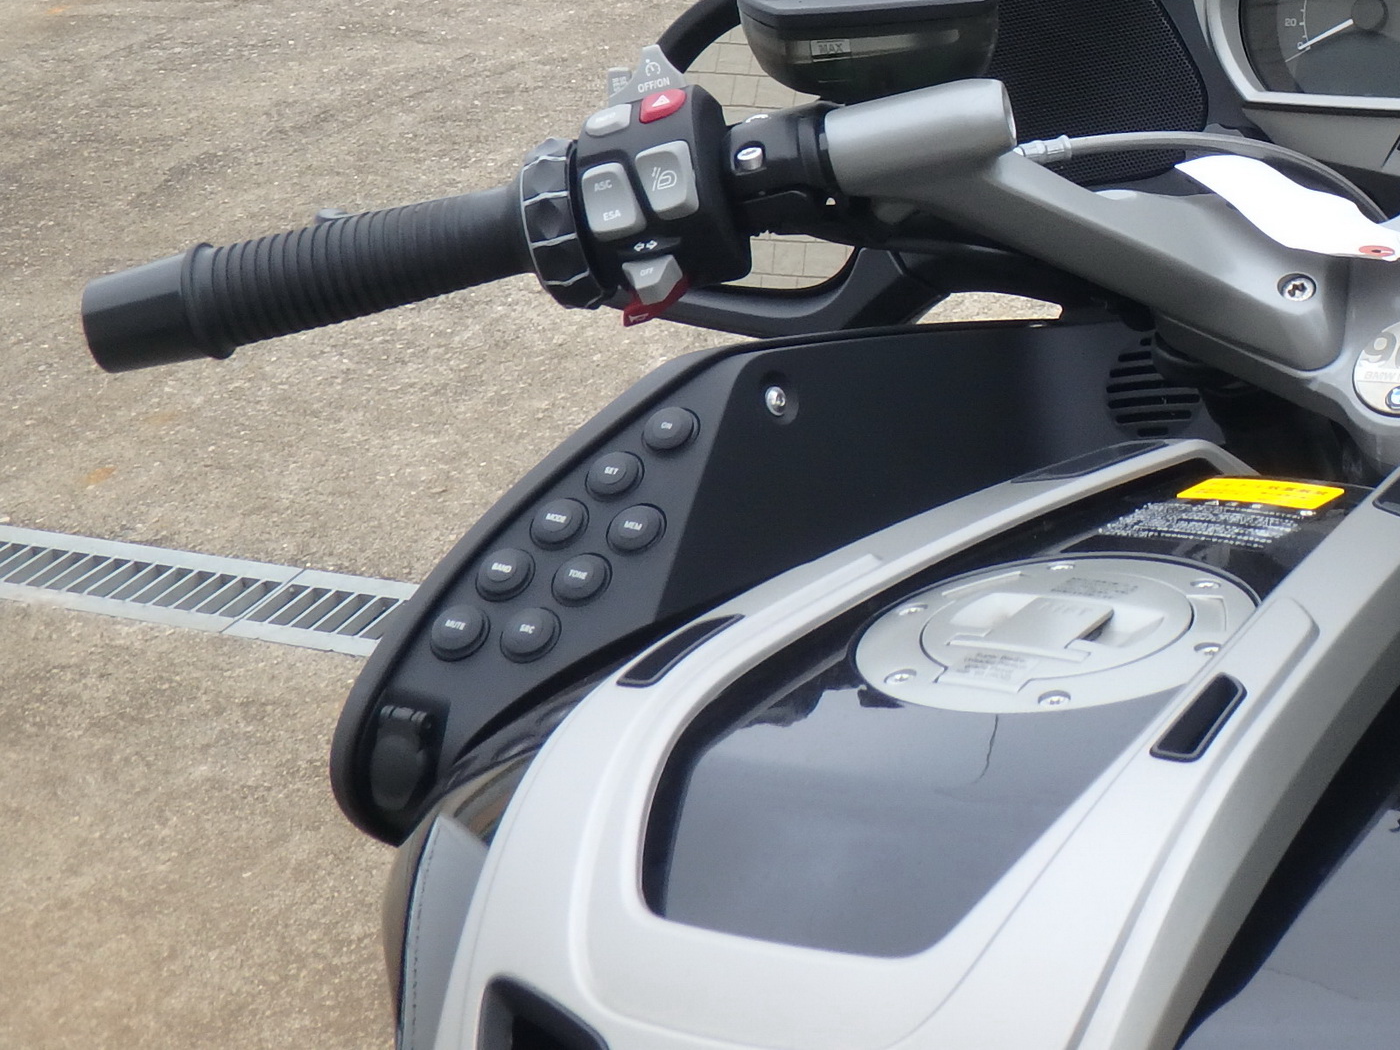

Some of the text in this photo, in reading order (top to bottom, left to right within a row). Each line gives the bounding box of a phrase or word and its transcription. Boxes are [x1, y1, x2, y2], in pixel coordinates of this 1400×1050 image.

[1284, 18, 1297, 27] 20
[817, 42, 844, 55] MAX
[637, 77, 671, 93] OFF/ON
[594, 179, 613, 192] ASC
[602, 209, 622, 222] ESA
[639, 267, 654, 277] OFF
[1363, 370, 1397, 381] BMW
[604, 466, 619, 475] SET
[623, 520, 643, 531] MEM
[491, 562, 513, 574] BAND
[568, 568, 589, 580] TONE
[444, 618, 467, 631] MUTE
[519, 623, 536, 635] SRC
